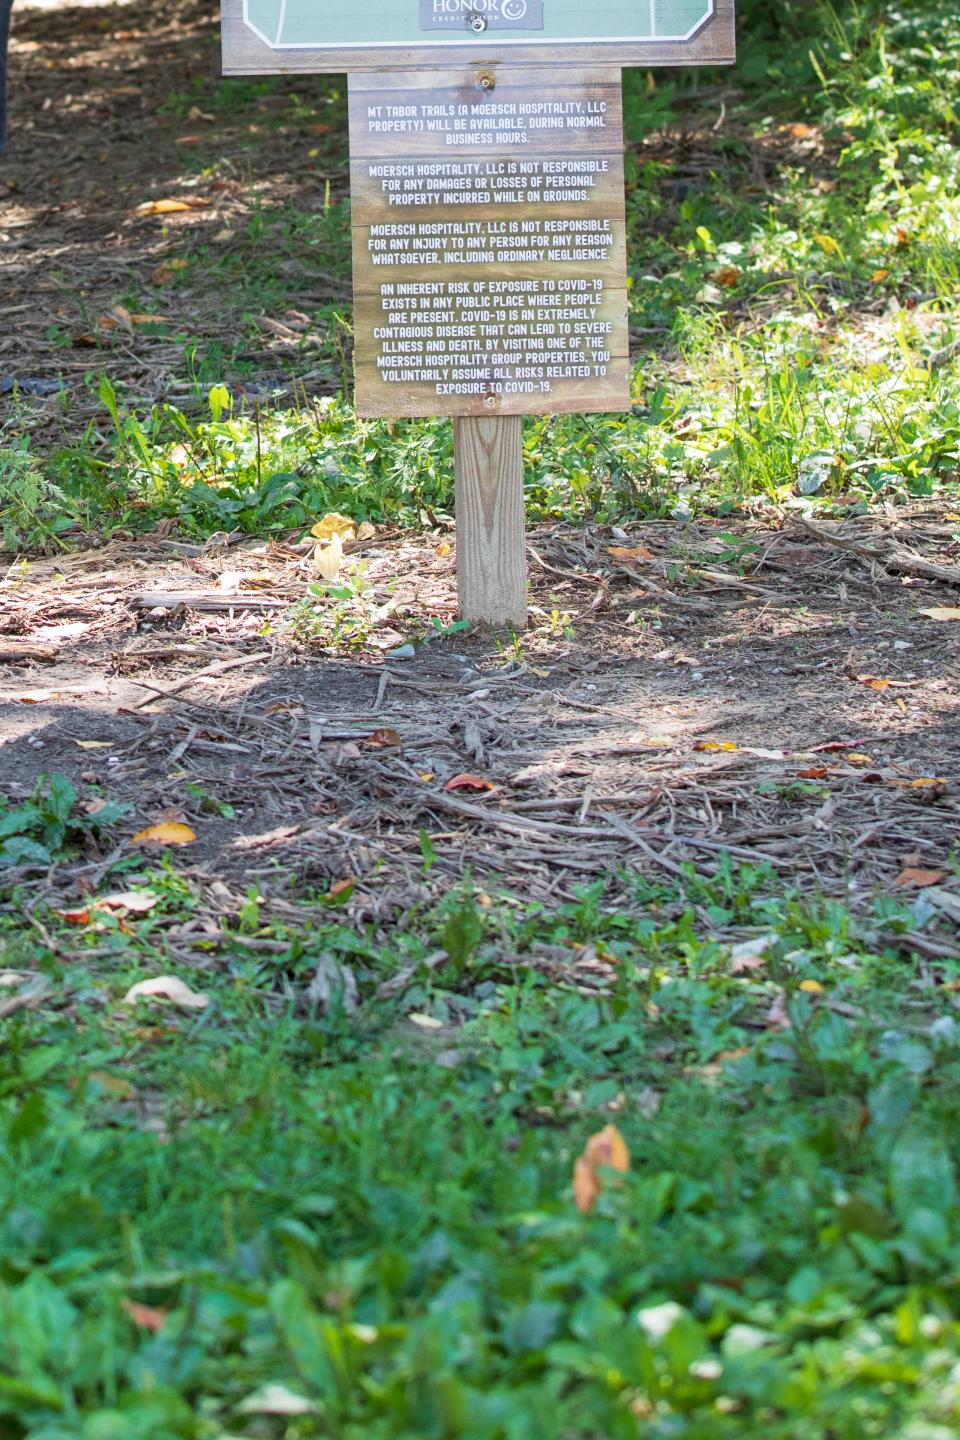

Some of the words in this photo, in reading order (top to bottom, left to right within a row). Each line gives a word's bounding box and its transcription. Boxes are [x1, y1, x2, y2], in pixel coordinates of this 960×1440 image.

[368, 106, 382, 119] MT
[386, 105, 416, 119] TABOR
[421, 105, 454, 118] TRAILS
[471, 103, 515, 117] MOERSCH
[587, 102, 606, 114] LLC
[427, 119, 450, 132] WILL
[454, 118, 466, 131] BE
[529, 116, 563, 130] DURING
[566, 115, 606, 129] NORMAL
[446, 132, 492, 145] BUSINESS
[496, 132, 529, 144] HOURS.
[369, 165, 414, 177] MOERSCH
[486, 163, 504, 175] LLC
[508, 162, 516, 175] IS
[520, 162, 539, 174] NOT
[542, 161, 607, 174] RESPONSIBLE
[382, 179, 400, 192] FOR
[404, 179, 423, 191] ANY
[427, 178, 471, 191] DAMAGES
[474, 178, 486, 190] OR
[490, 177, 526, 189] LOSSES
[530, 177, 542, 189] OF
[546, 176, 595, 188] PERSONAL
[389, 193, 439, 206] PROPERTY
[444, 192, 490, 205] INCURRED
[493, 191, 523, 204] WHILE
[527, 191, 539, 203] ON
[543, 190, 589, 203] GROUNDS.
[370, 224, 415, 237] MOERSCH
[488, 222, 505, 235] LLC
[509, 221, 518, 234] IS
[522, 221, 540, 234] NOT
[544, 220, 609, 233] RESPONSIBLE
[368, 239, 387, 251] FOR
[390, 239, 409, 250] ANY
[413, 237, 447, 250] INJURY
[451, 237, 463, 249] TO
[467, 236, 486, 249] ANY
[490, 235, 527, 249] PERSON
[531, 235, 548, 248] FOR
[552, 234, 571, 247] ANY
[575, 234, 612, 247] REASON
[444, 250, 494, 263] INCLUDING
[498, 249, 544, 262] ORDINARY
[548, 248, 609, 261] NEGLIGENCE.
[380, 283, 393, 296] AN
[397, 282, 444, 296] INHERENT
[448, 282, 469, 294] RISK
[473, 282, 485, 294] OF
[489, 281, 538, 294] EXPOSURE
[542, 280, 554, 292] TO
[558, 280, 602, 292] COVID-19
[382, 297, 416, 310] EXISTS
[420, 297, 430, 309] IN
[433, 296, 452, 309] ANY
[456, 296, 490, 308] PUBLIC
[493, 295, 524, 307] PLACE
[528, 294, 560, 307] WHERE
[564, 294, 601, 306] PEOPLE
[389, 311, 406, 324] ARE
[410, 310, 457, 324] PRESENT.
[461, 309, 505, 323] COVID-19
[509, 309, 518, 322] IS
[522, 309, 534, 321] AN
[538, 308, 595, 321] EXTREMELY
[374, 325, 432, 339] CONTAGIOUS
[436, 324, 475, 338] DISEASE
[479, 324, 504, 337] THAT
[508, 323, 526, 336] CAN
[530, 323, 554, 336] LEAD
[558, 322, 570, 335] TO
[574, 322, 611, 335] SEVERE
[383, 340, 422, 353] ILLNESS
[426, 339, 445, 352] AND
[448, 340, 482, 351] DEATH.
[486, 339, 499, 350] BY
[502, 338, 543, 350] VISITING
[547, 337, 565, 349] ONE
[569, 337, 580, 349] OF
[585, 337, 603, 348] THE
[377, 355, 422, 367] MOERSCH
[425, 353, 487, 366] HOSPITALITY
[492, 352, 522, 365] GROUP
[591, 350, 610, 362] YOU
[382, 368, 448, 382] VOLUNTARILY
[452, 367, 490, 380] ASSUME
[494, 367, 511, 380] ALL
[516, 366, 543, 379] RISKS
[546, 365, 590, 378] RELATED
[593, 365, 606, 377] TO
[436, 383, 486, 395] EXPOSURE
[489, 382, 501, 393] TO
[505, 381, 553, 393] COVID-19.
